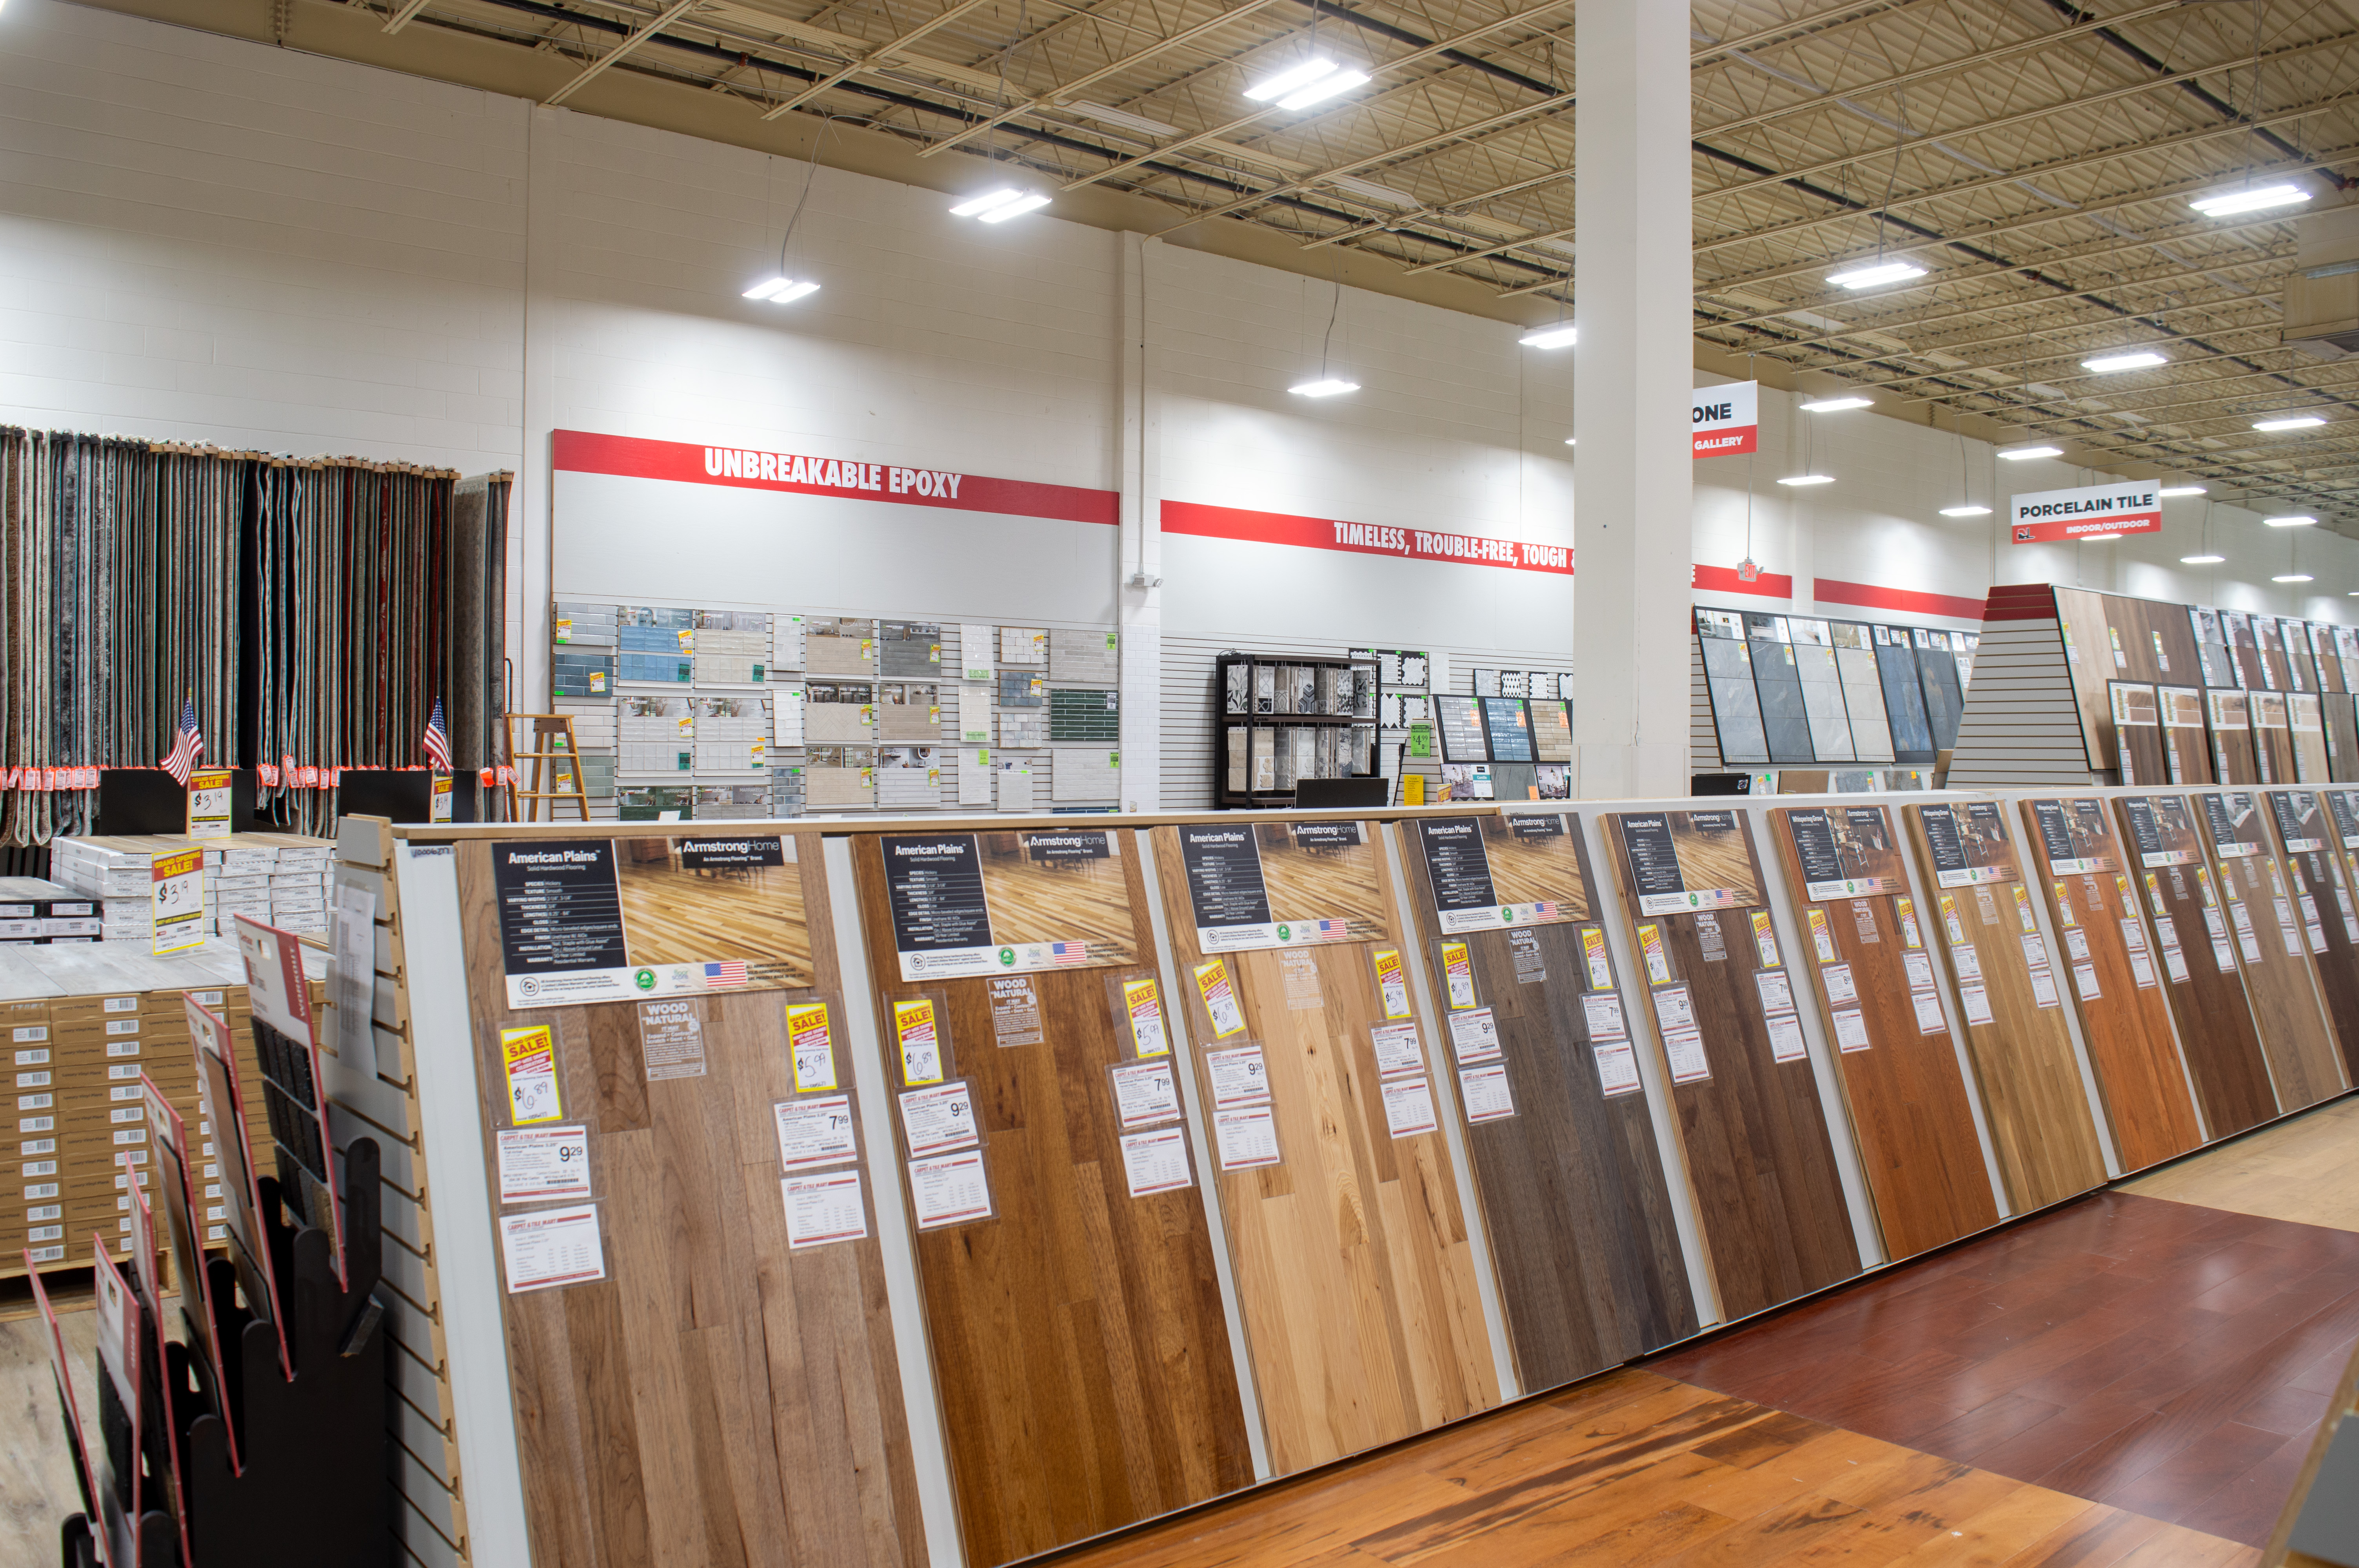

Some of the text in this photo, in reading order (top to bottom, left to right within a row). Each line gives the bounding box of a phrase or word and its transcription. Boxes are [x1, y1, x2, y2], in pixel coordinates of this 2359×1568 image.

[1694, 436, 1744, 450] GALLERY
[705, 447, 961, 499] UNBREAKABLE EPOXY
[2020, 494, 2153, 518] PORCELAIN TILE
[2066, 519, 2150, 534] INDOOR/OUTDOOR
[1334, 522, 1410, 555] TIMELESS,
[1415, 531, 1519, 566] TROUBLE-FREE,
[1522, 544, 1567, 568] TOUGH
[1745, 564, 1756, 579] EXIT
[198, 779, 223, 789] SALE!
[438, 784, 449, 793] SALE!
[1428, 826, 1454, 835] American
[1190, 833, 1223, 842] American
[895, 844, 937, 855] American
[154, 851, 201, 869] GRAND OPENING
[509, 851, 563, 864] American
[164, 860, 193, 877] SALE!
[1511, 930, 1532, 939] WOOD
[1586, 935, 1602, 947] SALE!
[1643, 931, 1658, 944] SALE!
[1283, 950, 1310, 960] WOOD
[1446, 950, 1466, 963] SALE!
[1379, 958, 1399, 972] SALE!
[289, 946, 306, 1017] WORKOUT
[993, 979, 1027, 990] WOOD
[1201, 968, 1225, 988] SALE!
[1138, 984, 1154, 993] OPENING
[1130, 986, 1156, 1005] SALE!
[646, 1002, 689, 1015] WOOD
[805, 1009, 825, 1018] OPENING
[913, 1005, 931, 1014] OPENING
[792, 1013, 826, 1031] SALE!
[900, 1009, 932, 1027] SALE!
[505, 1031, 547, 1048] GRAND OPENING
[509, 1036, 549, 1058] SALE!
